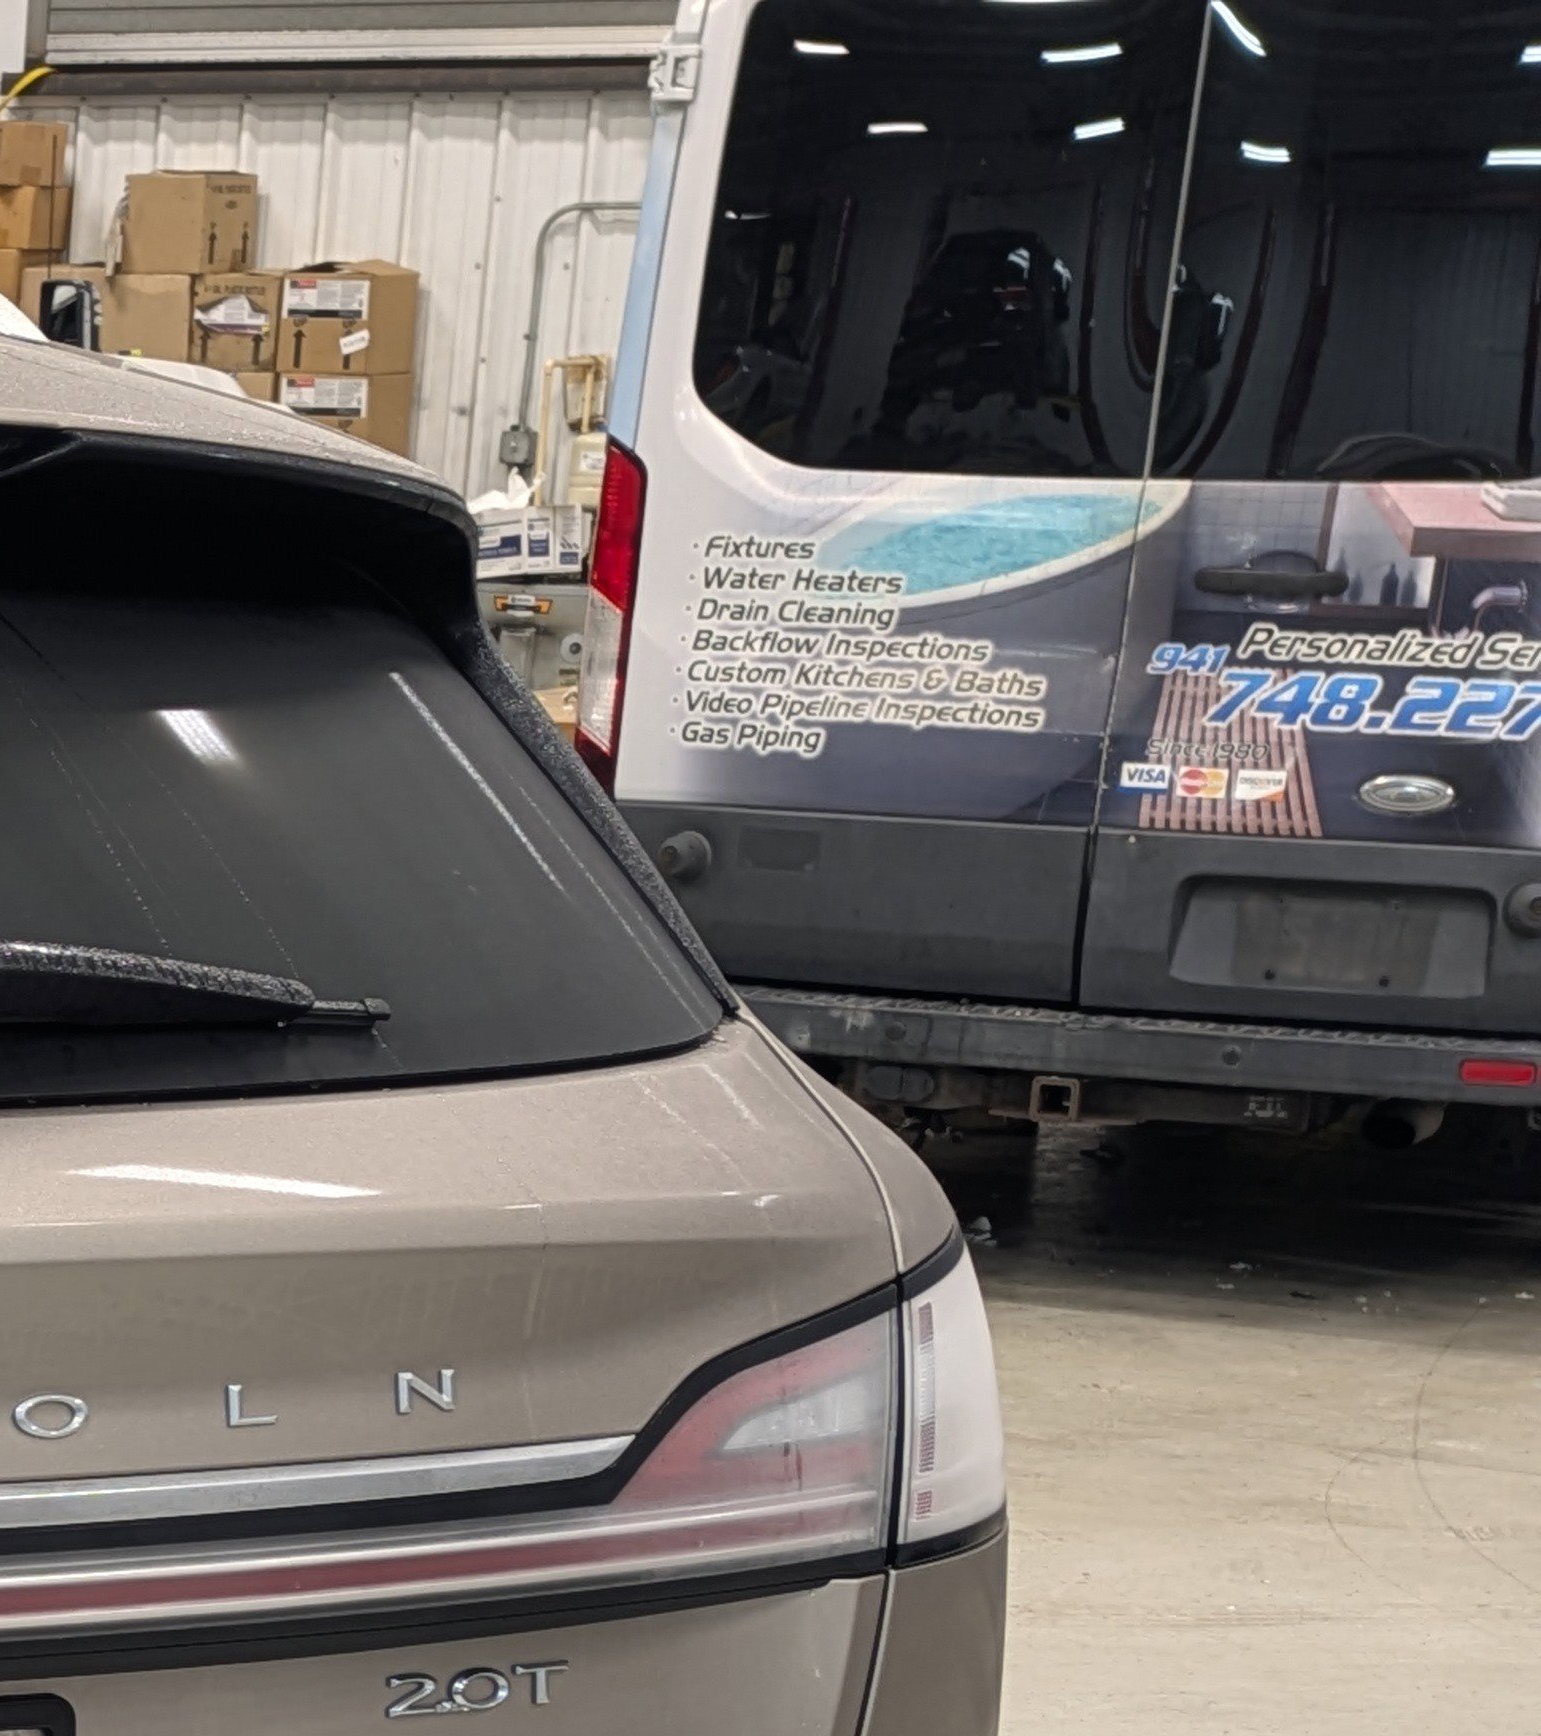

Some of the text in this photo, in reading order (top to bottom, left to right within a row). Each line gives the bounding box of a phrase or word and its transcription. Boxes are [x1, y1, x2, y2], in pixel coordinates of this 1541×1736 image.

[703, 535, 816, 559] Fixtures
[703, 566, 904, 594] Water Heaters
[697, 598, 896, 631] Drain Cleaning
[691, 629, 990, 663] Backflow Inspections
[1147, 644, 1230, 674] 941
[1239, 624, 1480, 667] Personalized
[687, 659, 1044, 697] Custom Kitchens & Baths
[686, 690, 1042, 728] Video Pipeline Inspections
[681, 721, 822, 754] Gas Piping
[1126, 768, 1167, 784] VISA
